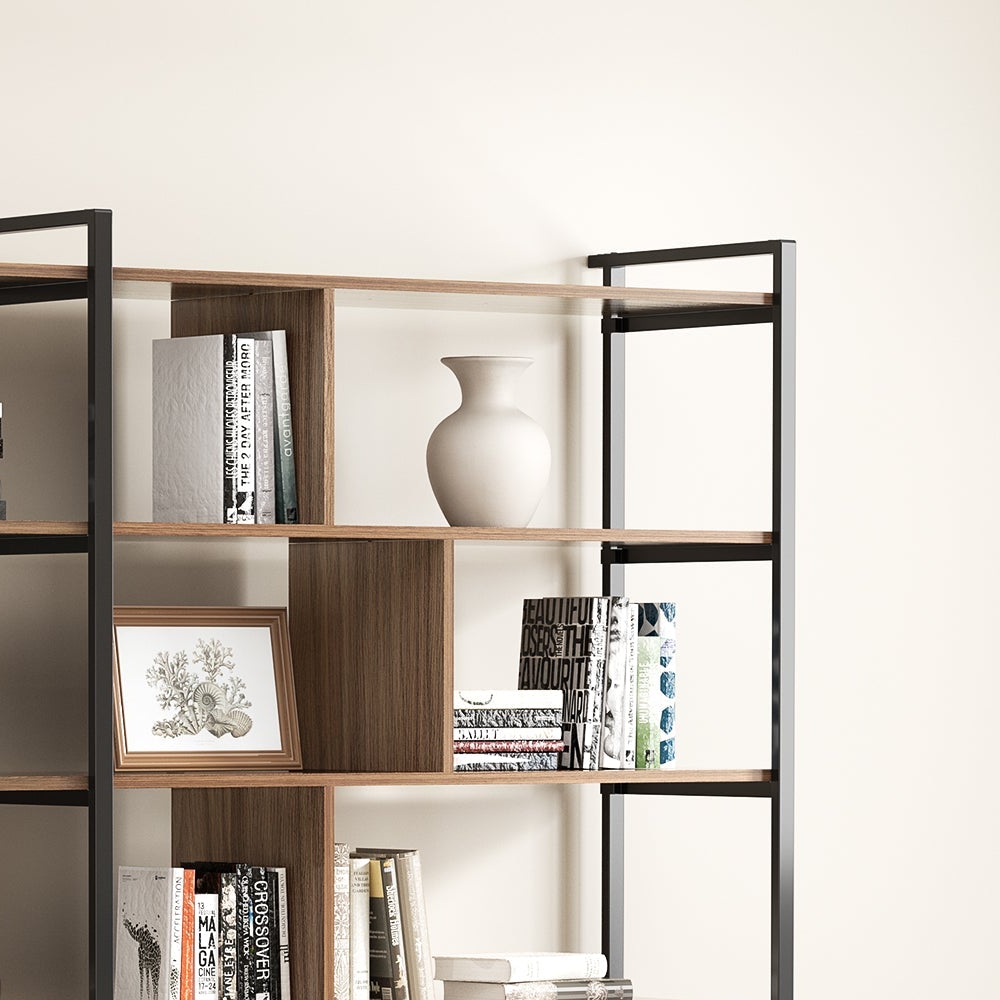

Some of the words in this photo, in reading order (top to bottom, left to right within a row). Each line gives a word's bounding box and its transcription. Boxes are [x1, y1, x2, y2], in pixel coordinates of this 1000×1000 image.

[281, 365, 292, 457] avantgarde
[197, 902, 205, 910] 13
[253, 880, 270, 980] CROSSOVER
[199, 933, 216, 949] LA
[199, 950, 216, 967] GA
[224, 939, 234, 967] EYRE
[199, 967, 216, 977] CINE
[198, 982, 217, 991] 17-24
[224, 971, 234, 998] JANE
